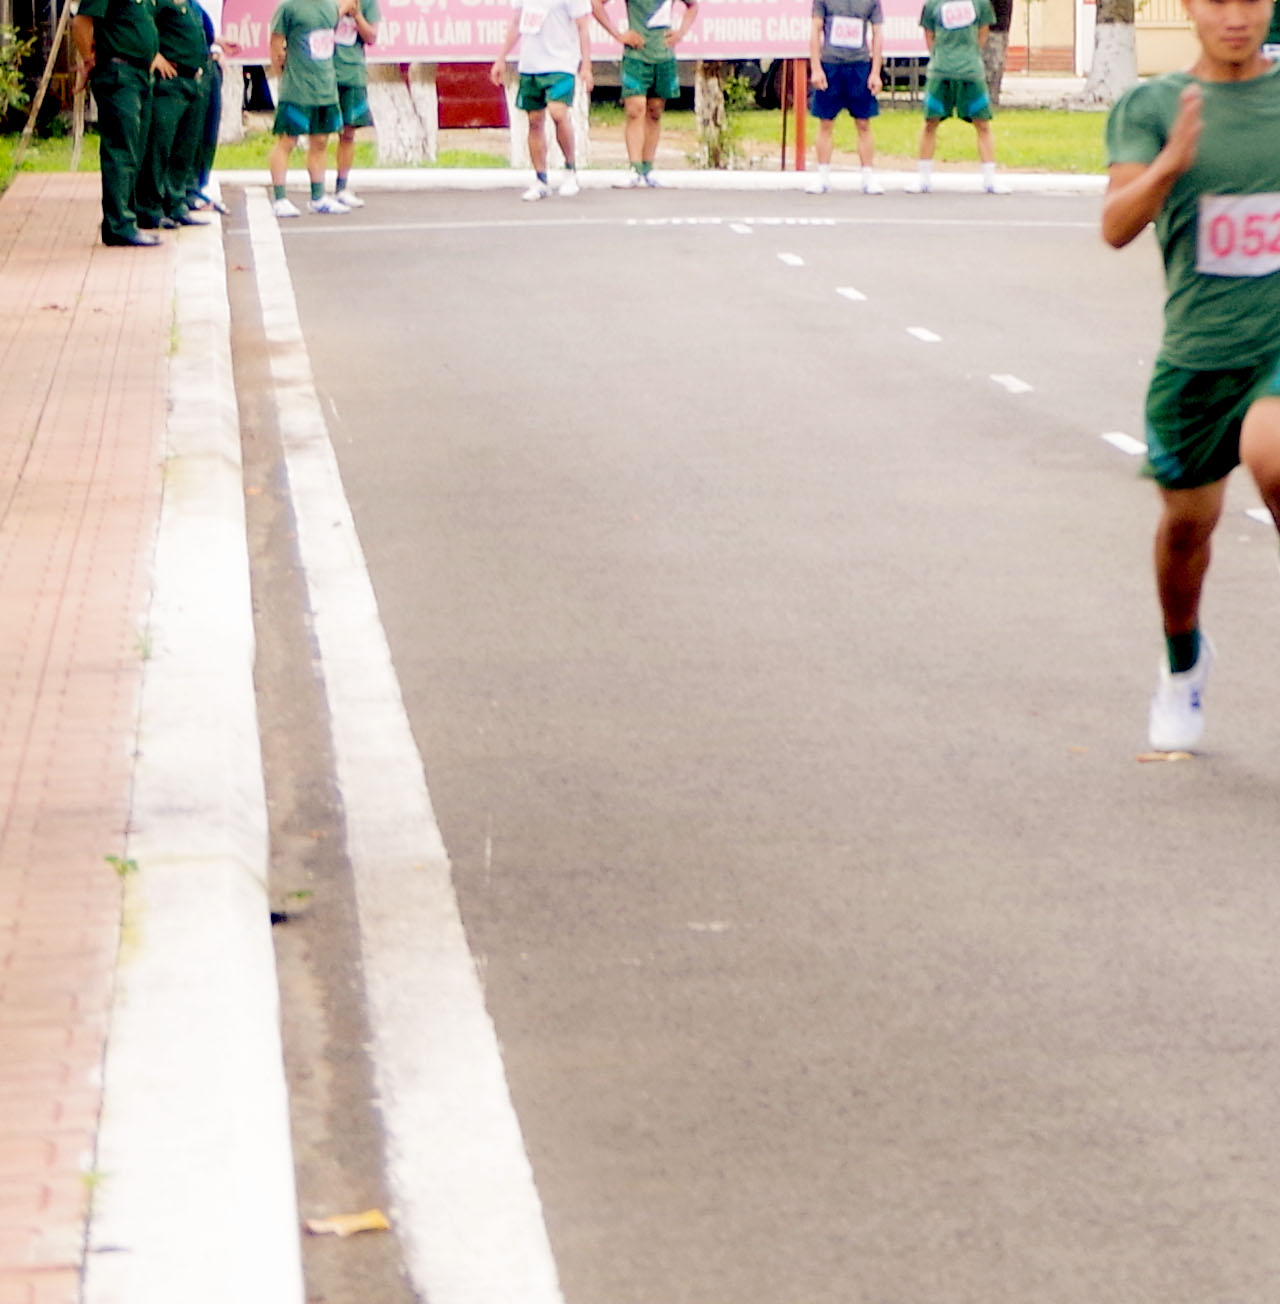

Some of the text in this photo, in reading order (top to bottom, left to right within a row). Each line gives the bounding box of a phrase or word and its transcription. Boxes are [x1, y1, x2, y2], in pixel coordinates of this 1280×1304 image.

[377, 15, 401, 51] ẬP
[406, 15, 430, 45] VÀ
[433, 15, 472, 45] LÀM
[477, 20, 508, 45] THE
[703, 17, 762, 42] PHONG
[766, 12, 812, 41] CÁCH
